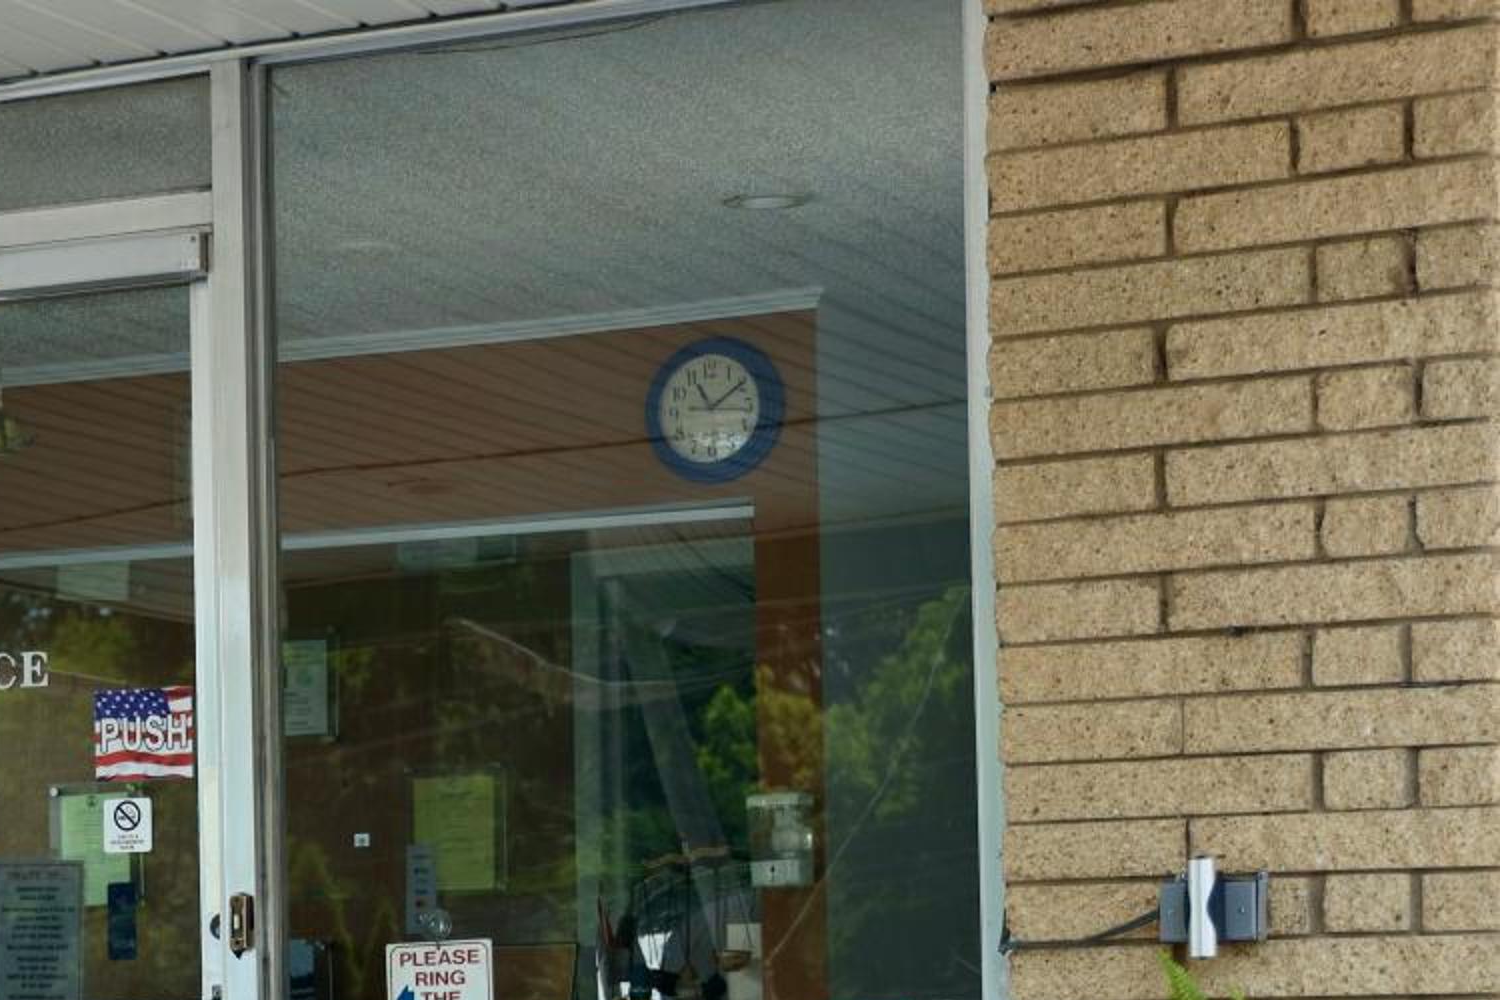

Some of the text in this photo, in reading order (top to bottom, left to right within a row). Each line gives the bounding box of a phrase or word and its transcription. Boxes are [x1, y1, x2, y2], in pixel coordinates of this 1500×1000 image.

[100, 713, 189, 753] PUSH
[400, 950, 479, 966] PLEASE
[415, 970, 465, 986] RING
